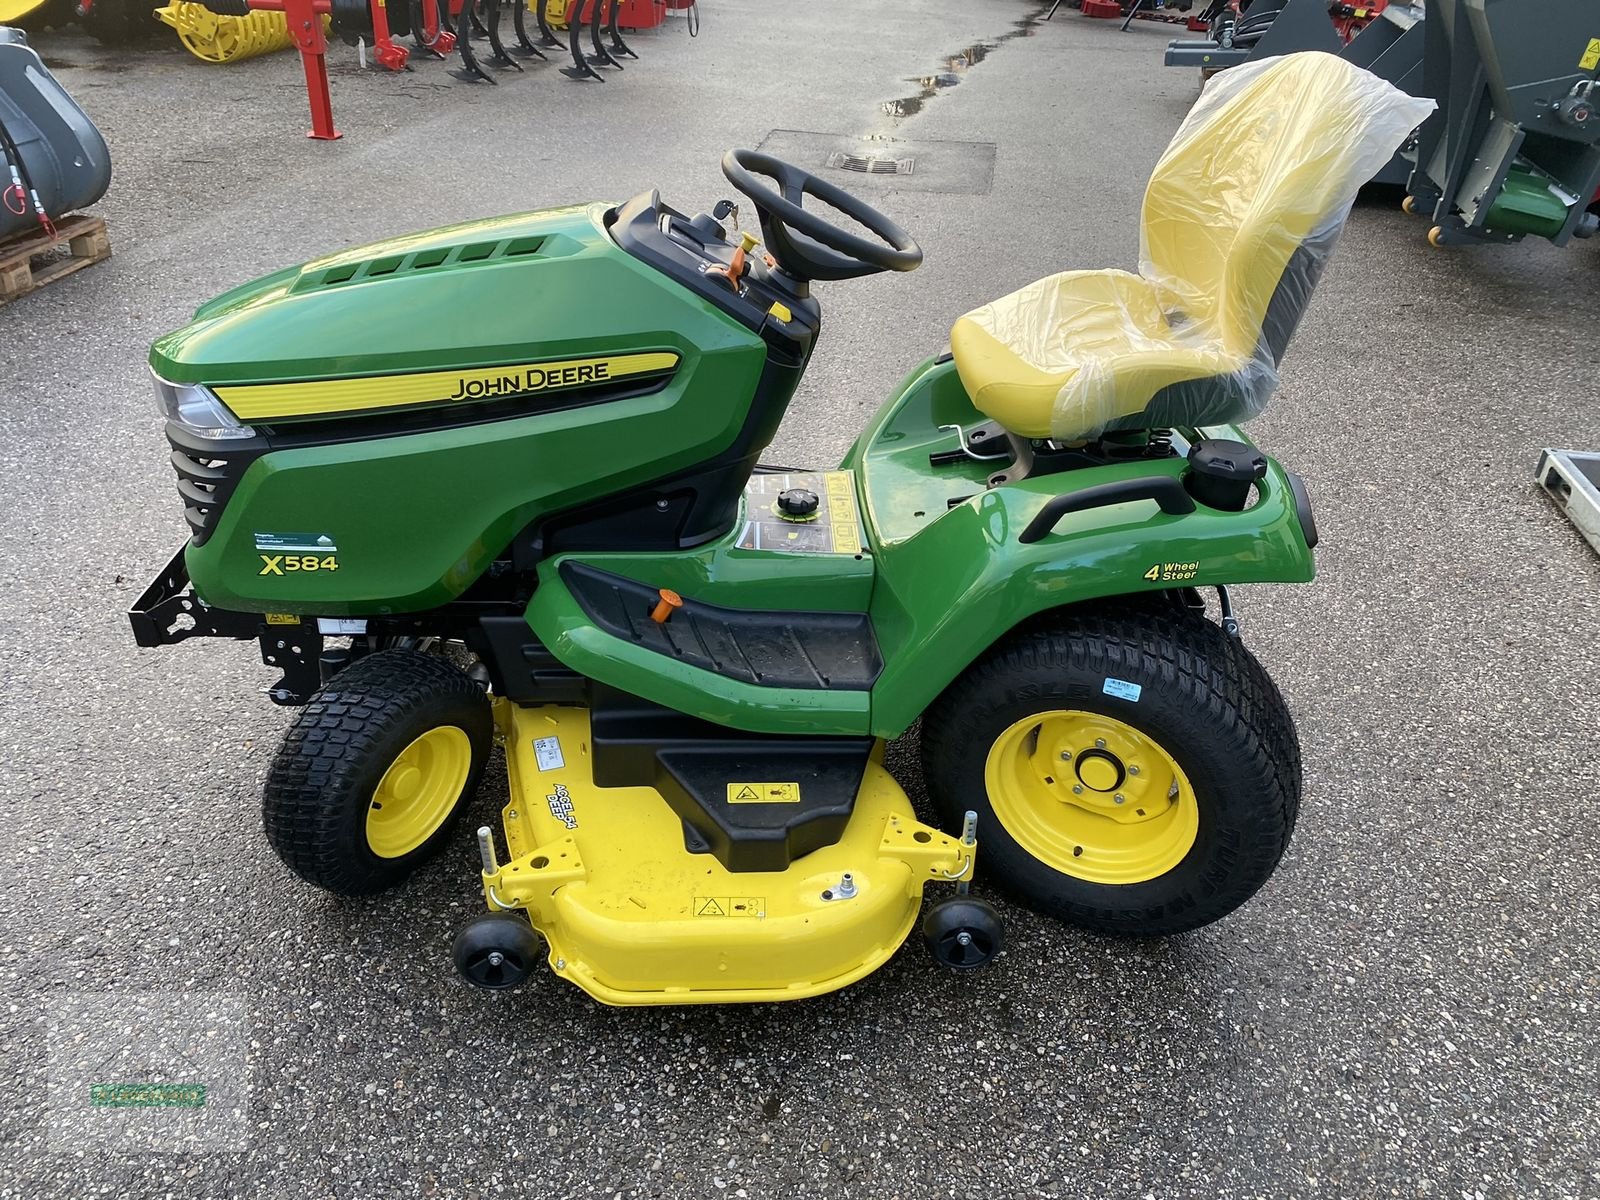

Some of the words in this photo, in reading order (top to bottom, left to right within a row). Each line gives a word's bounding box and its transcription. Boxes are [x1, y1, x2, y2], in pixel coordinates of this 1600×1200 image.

[451, 374, 521, 400] JOHN
[526, 362, 610, 390] DEERE
[258, 554, 339, 576] X584
[1143, 563, 1161, 581] 4
[1163, 560, 1200, 572] Wheel
[1162, 571, 1197, 581] Steer
[546, 794, 564, 821] DEEP
[553, 784, 574, 815] ACCEL
[564, 815, 578, 830] 54
